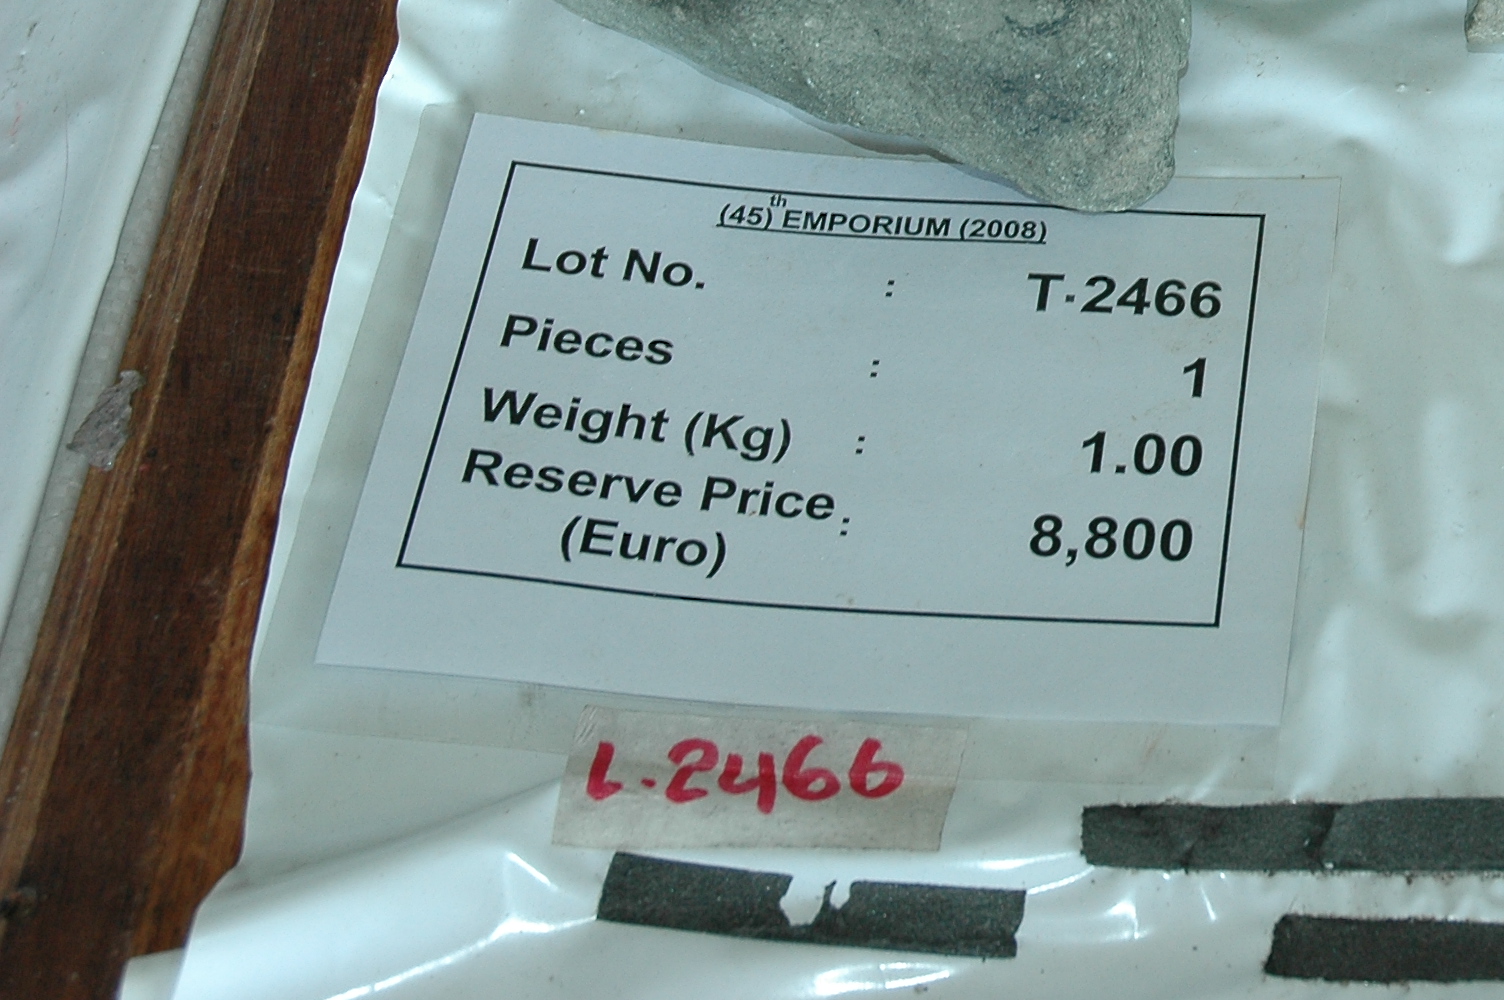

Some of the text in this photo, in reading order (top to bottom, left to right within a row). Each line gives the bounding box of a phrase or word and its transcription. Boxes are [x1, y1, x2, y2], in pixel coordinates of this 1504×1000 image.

[521, 237, 610, 280] Lot
[621, 247, 706, 290] No.
[782, 209, 952, 238] EMPORIUM
[959, 217, 1047, 244] (2008)
[499, 313, 674, 366] Pieces
[1182, 357, 1207, 399] 1
[483, 386, 670, 445] Weight
[684, 410, 792, 465] (Kg)
[1081, 430, 1203, 478] 1.00
[461, 447, 683, 508] Reserve
[699, 475, 835, 521] Price
[1029, 513, 1193, 568] 8,800
[560, 515, 727, 579] (Euro)
